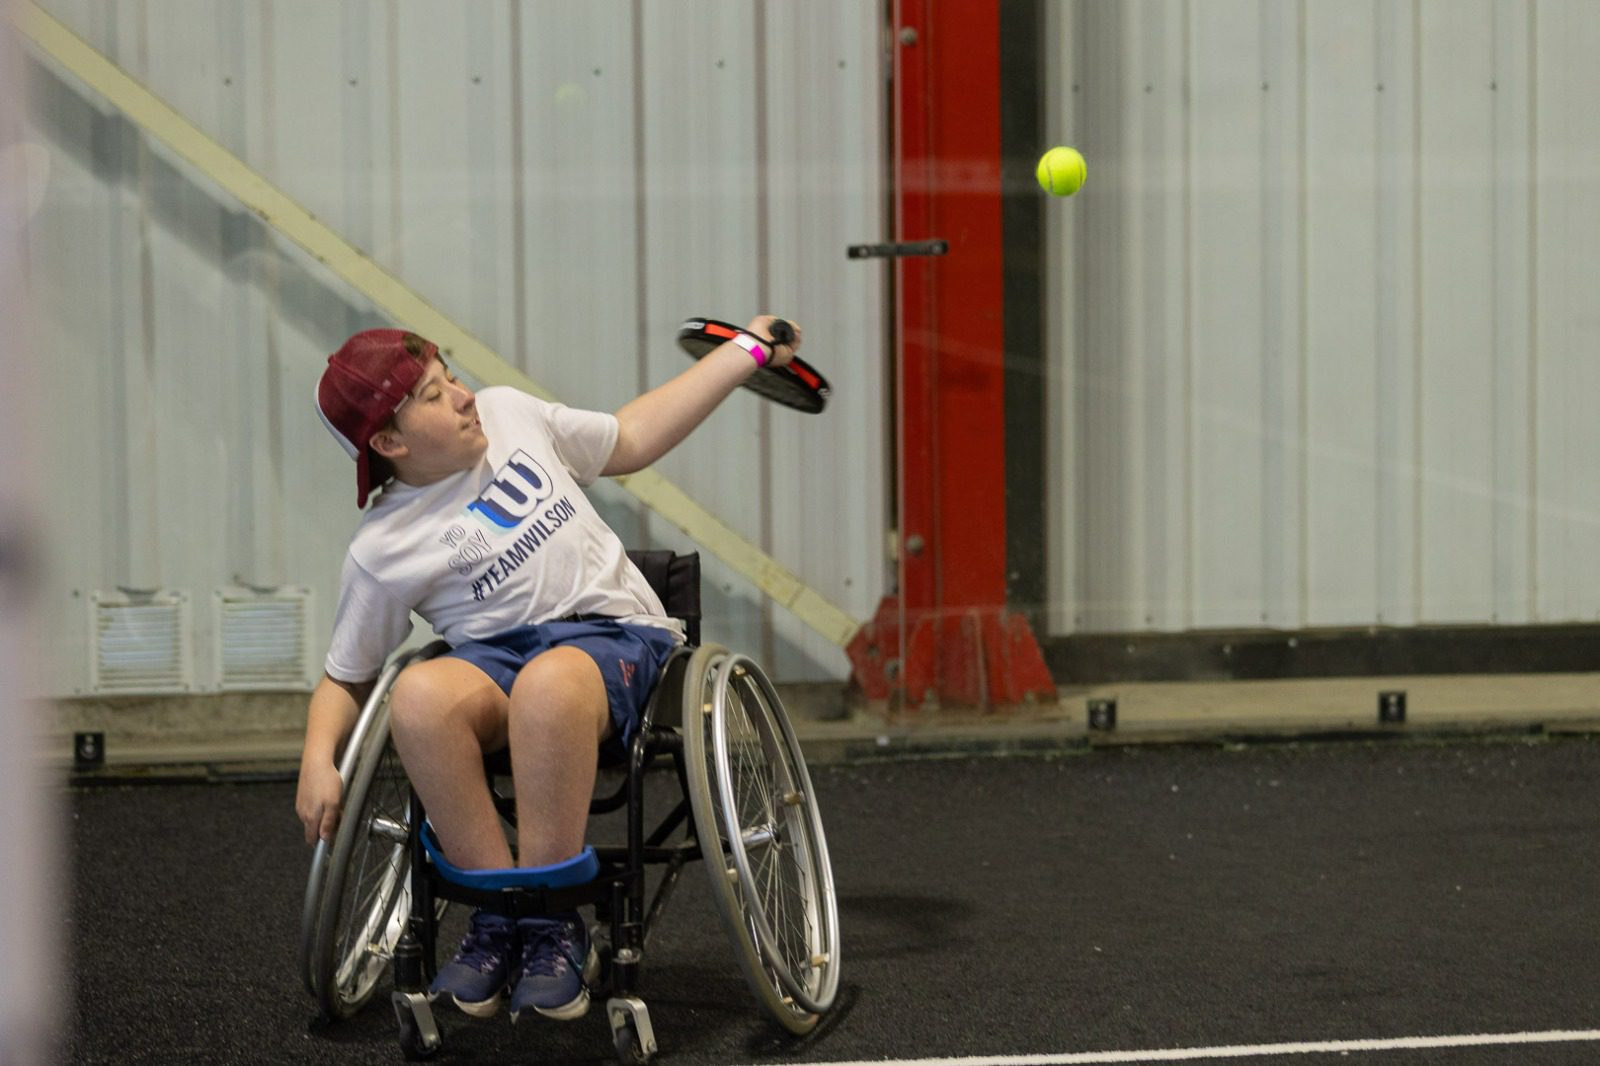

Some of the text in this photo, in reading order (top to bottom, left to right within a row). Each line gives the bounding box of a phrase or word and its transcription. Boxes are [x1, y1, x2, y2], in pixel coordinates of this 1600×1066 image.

[439, 524, 466, 549] YO
[448, 528, 492, 576] SOY
[471, 495, 577, 602] #TEAMWILSON
